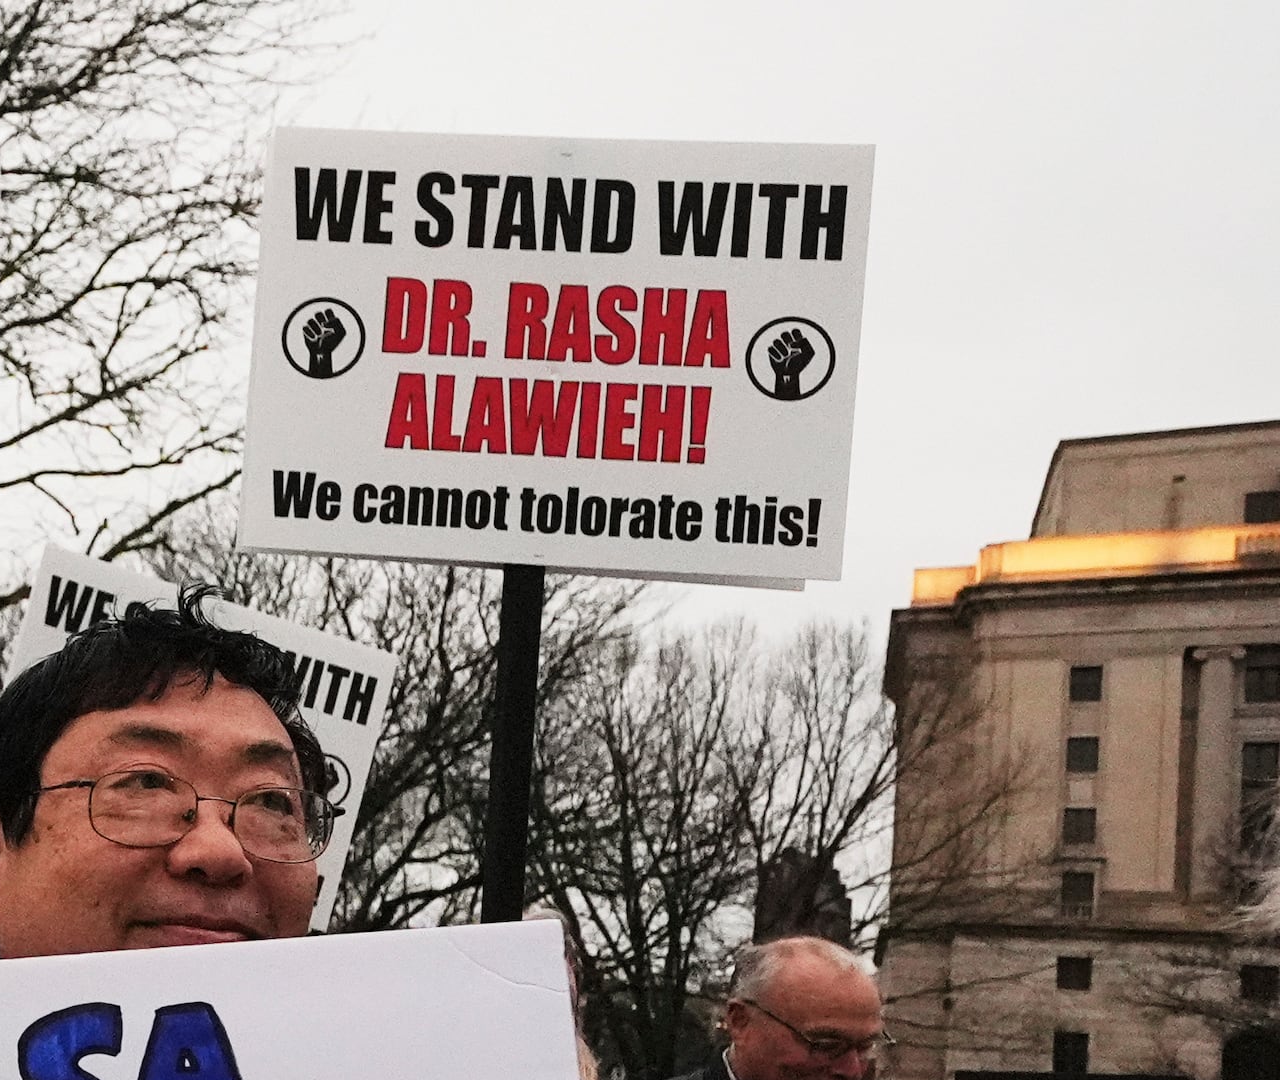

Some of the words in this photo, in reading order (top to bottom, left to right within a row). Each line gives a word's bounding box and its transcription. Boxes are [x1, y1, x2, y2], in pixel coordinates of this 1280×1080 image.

[294, 166, 397, 245] WE
[414, 171, 637, 254] STAND
[657, 180, 849, 261] WITH
[381, 276, 487, 357] DR.
[503, 281, 731, 368] RASHA
[384, 372, 713, 465] ALAWIEH!
[272, 469, 342, 522] We
[352, 481, 510, 531] cannot
[520, 485, 703, 541] tolorate
[714, 495, 823, 548] this!
